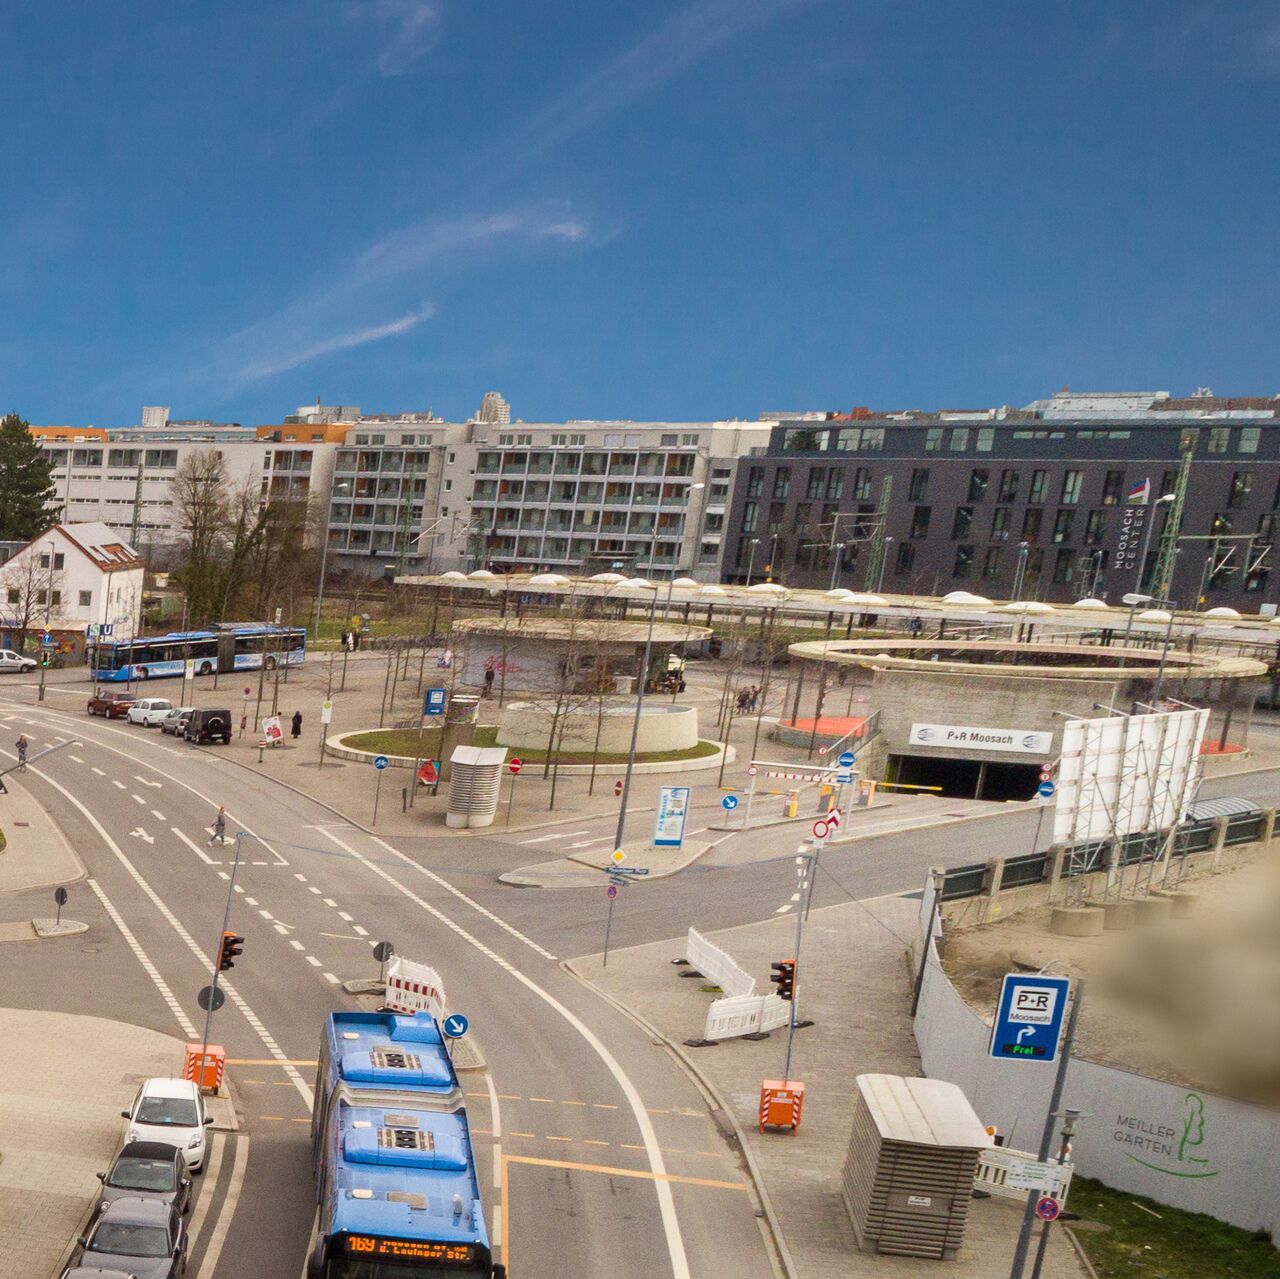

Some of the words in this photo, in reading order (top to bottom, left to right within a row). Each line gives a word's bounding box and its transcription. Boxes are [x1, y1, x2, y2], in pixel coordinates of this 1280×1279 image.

[1114, 509, 1135, 569] MOOSACH
[1125, 509, 1146, 569] CENTER
[104, 625, 112, 635] U
[946, 731, 967, 741] P+R
[969, 732, 1013, 744] Moosach
[1017, 994, 1049, 1008] P+R
[1009, 1013, 1051, 1022] Moosach
[1116, 1115, 1176, 1139] MEILLER
